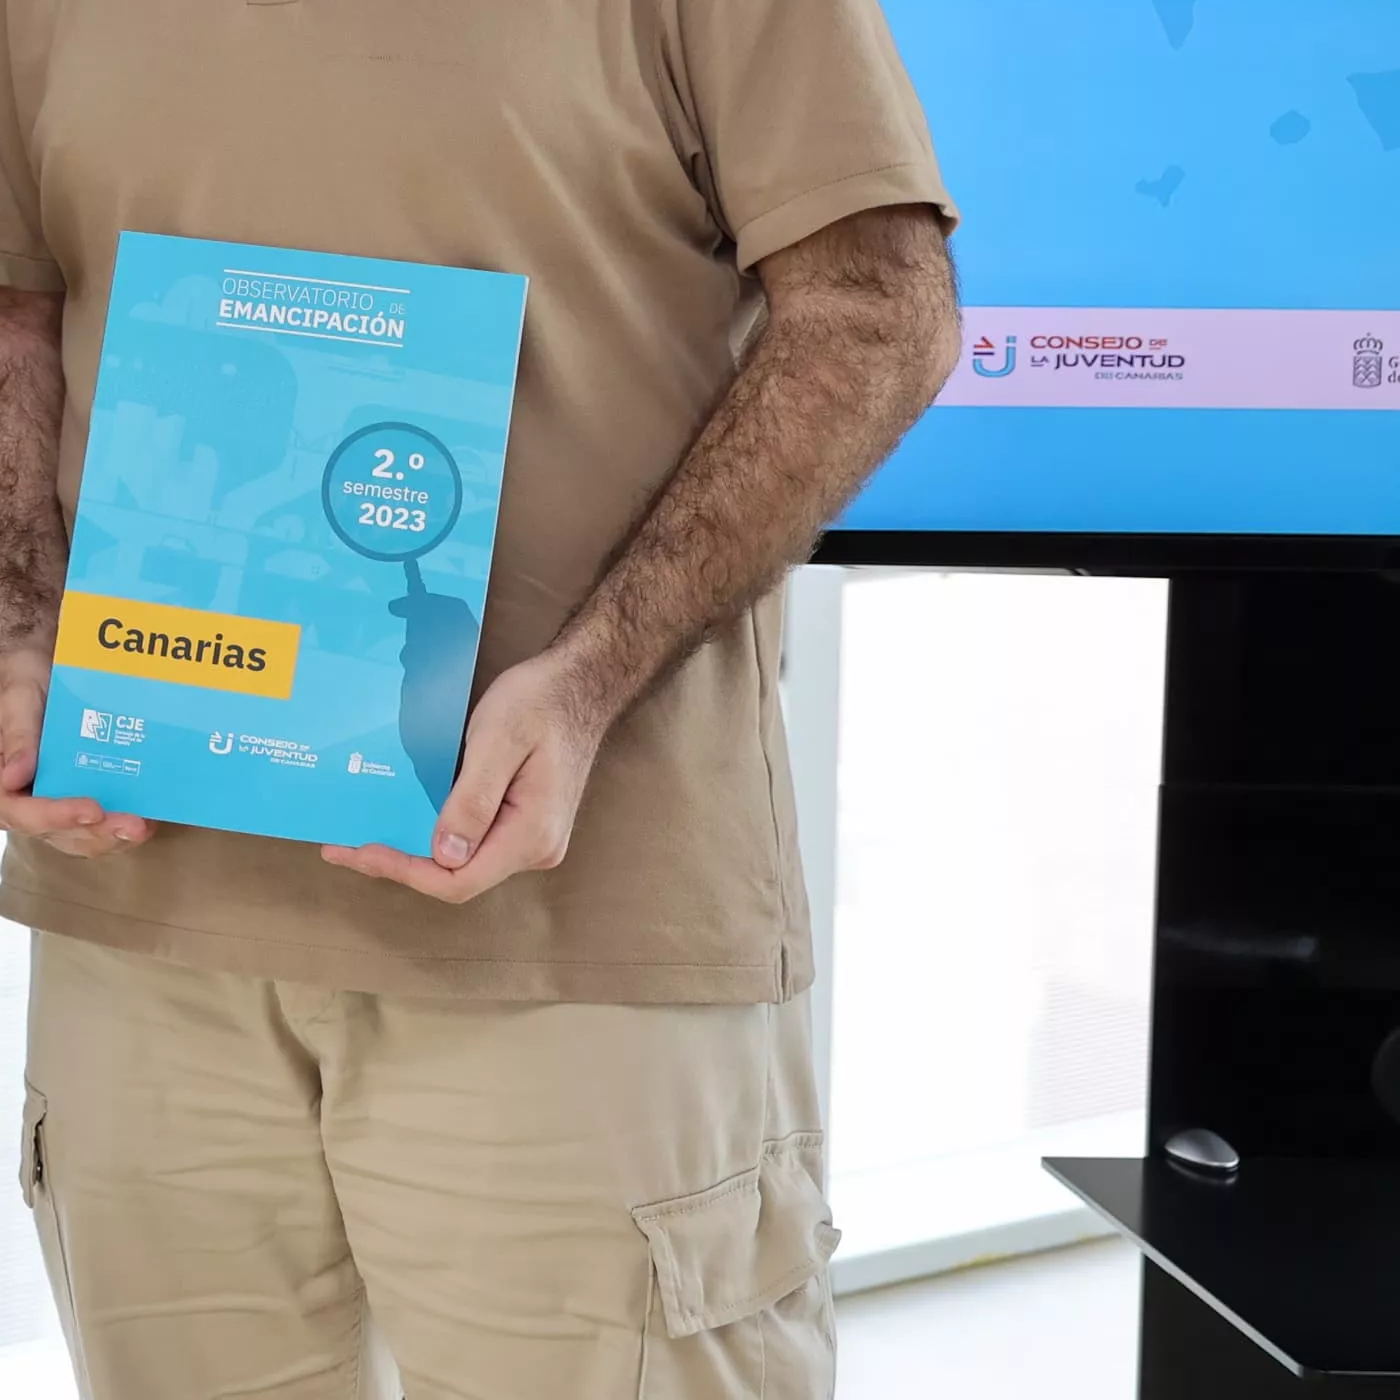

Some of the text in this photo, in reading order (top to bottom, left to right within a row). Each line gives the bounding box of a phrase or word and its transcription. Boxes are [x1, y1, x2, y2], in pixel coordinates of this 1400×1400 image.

[222, 277, 406, 315] OBSERVATORIO DE
[219, 298, 404, 338] EMANCIPACIÓN
[1030, 336, 1142, 350] CONSEJO
[1030, 354, 1185, 369] LA JUVENTUD
[1115, 372, 1183, 381] CANARIAS
[343, 481, 429, 504] semestre
[358, 502, 426, 532] 2023
[98, 618, 267, 672] Canarias
[116, 715, 145, 731] CJE
[250, 745, 318, 762] JUVENTUD
